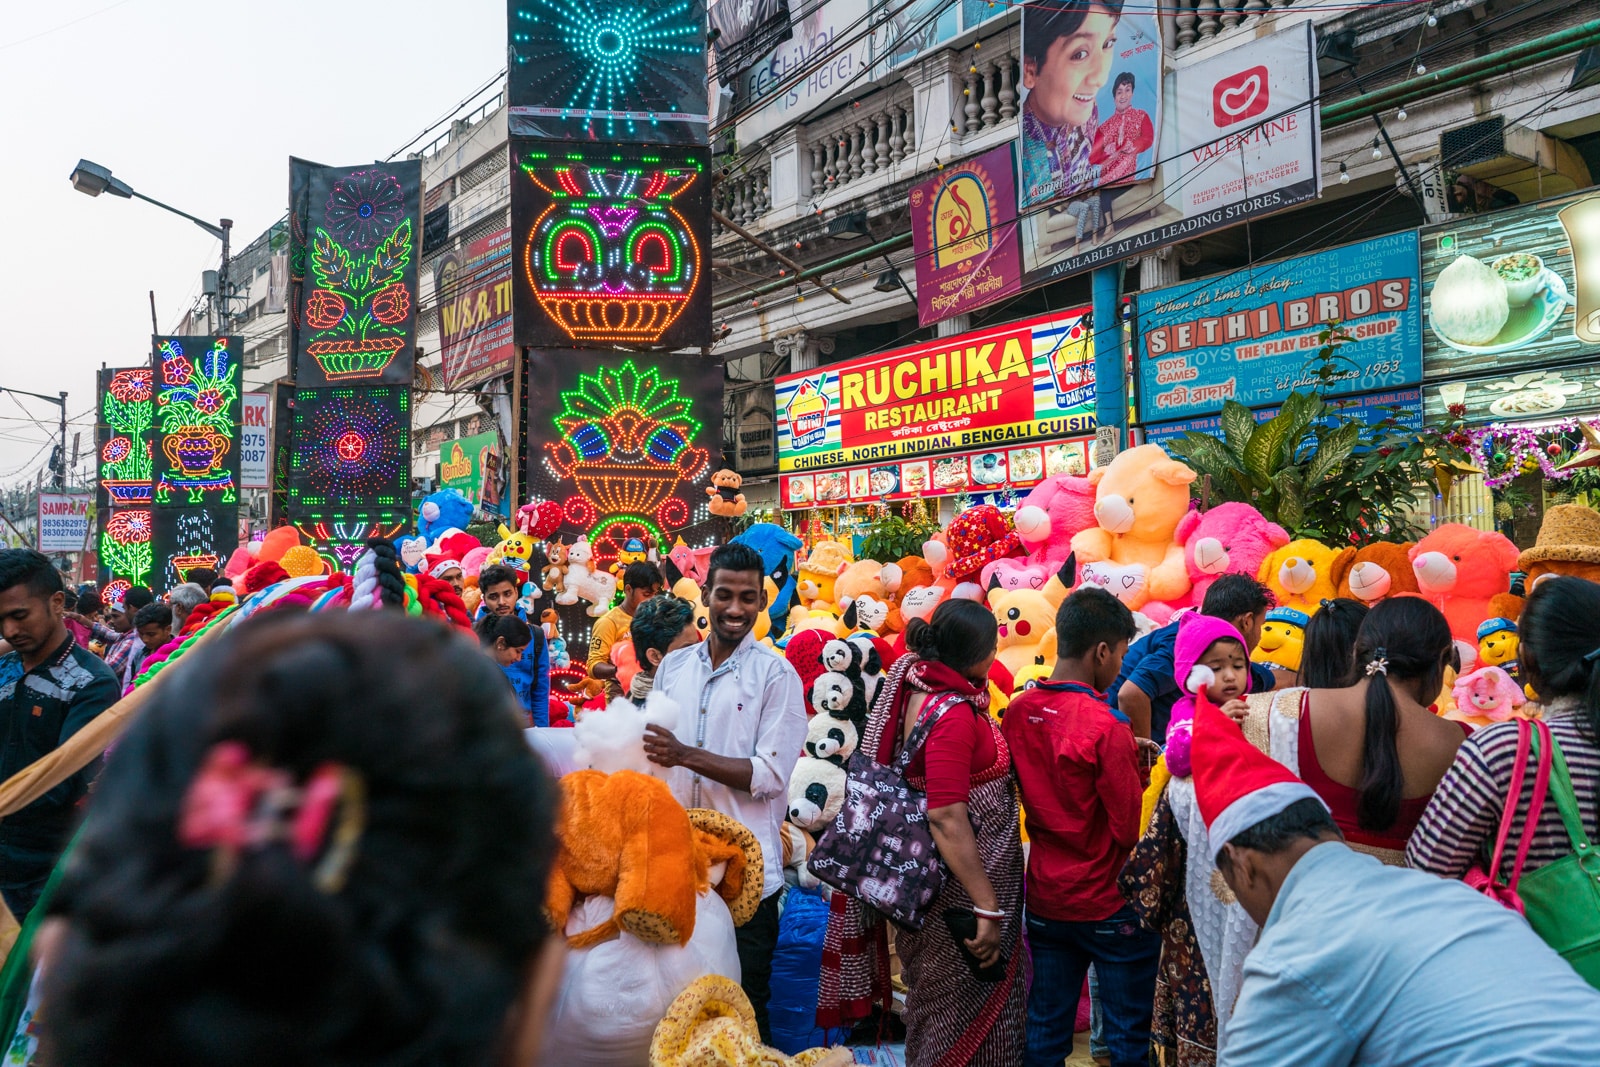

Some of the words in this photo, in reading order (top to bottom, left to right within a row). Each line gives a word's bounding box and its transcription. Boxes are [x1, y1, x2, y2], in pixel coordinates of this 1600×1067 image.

[1191, 114, 1298, 163] VALENTINE
[1193, 186, 1219, 199] FASHION
[1221, 174, 1254, 189] CLOTHING
[1256, 169, 1269, 178] FOR
[1271, 160, 1299, 174] LOUNGE
[1193, 194, 1215, 206] SLEEP
[1223, 182, 1252, 196] SPORTS
[1259, 166, 1300, 183] LINGERIE
[1051, 246, 1113, 277] AVAILABLE
[1117, 240, 1132, 254] AT
[1135, 232, 1159, 249] ALL
[1162, 211, 1222, 239] LEADING
[1226, 192, 1281, 219] STORES
[1362, 233, 1416, 253] INFANTS
[1278, 254, 1327, 272] INFANTS
[1354, 245, 1413, 263] EDUCATIONAL
[1341, 264, 1361, 275] RIDE
[1364, 260, 1383, 270] ONS
[1345, 268, 1382, 284] DOLLS
[1155, 301, 1189, 315] When
[1193, 291, 1211, 306] it's
[1214, 288, 1241, 302] time
[1244, 281, 1257, 296] to
[1151, 309, 1268, 353] SETHI
[1289, 282, 1404, 327] BROS
[1236, 345, 1260, 360] THE
[1357, 319, 1397, 338] SHOP
[1338, 340, 1375, 354] DOLLS
[1158, 359, 1185, 371] TOYS
[1186, 347, 1231, 367] TOYS
[841, 337, 1031, 411] RUCHIKA
[1157, 368, 1197, 383] GAMES
[1365, 359, 1401, 376] 1953
[1252, 376, 1273, 387] PRE
[1157, 388, 1188, 407] শেঠী
[1191, 378, 1235, 403] ব্রাদার্স
[865, 388, 1003, 431] RESTAURANT
[891, 425, 922, 438] রুচিকা
[1191, 418, 1209, 430] TOYS
[794, 451, 848, 469] CHINESE,
[852, 444, 897, 461] NORTH
[902, 435, 957, 453] INDIAN,
[962, 422, 1031, 445] BENGALI
[1037, 414, 1097, 435] CUISIN
[42, 502, 87, 516] SAMPAK
[42, 519, 88, 528] 9836362975
[814, 857, 842, 871] ROCK
